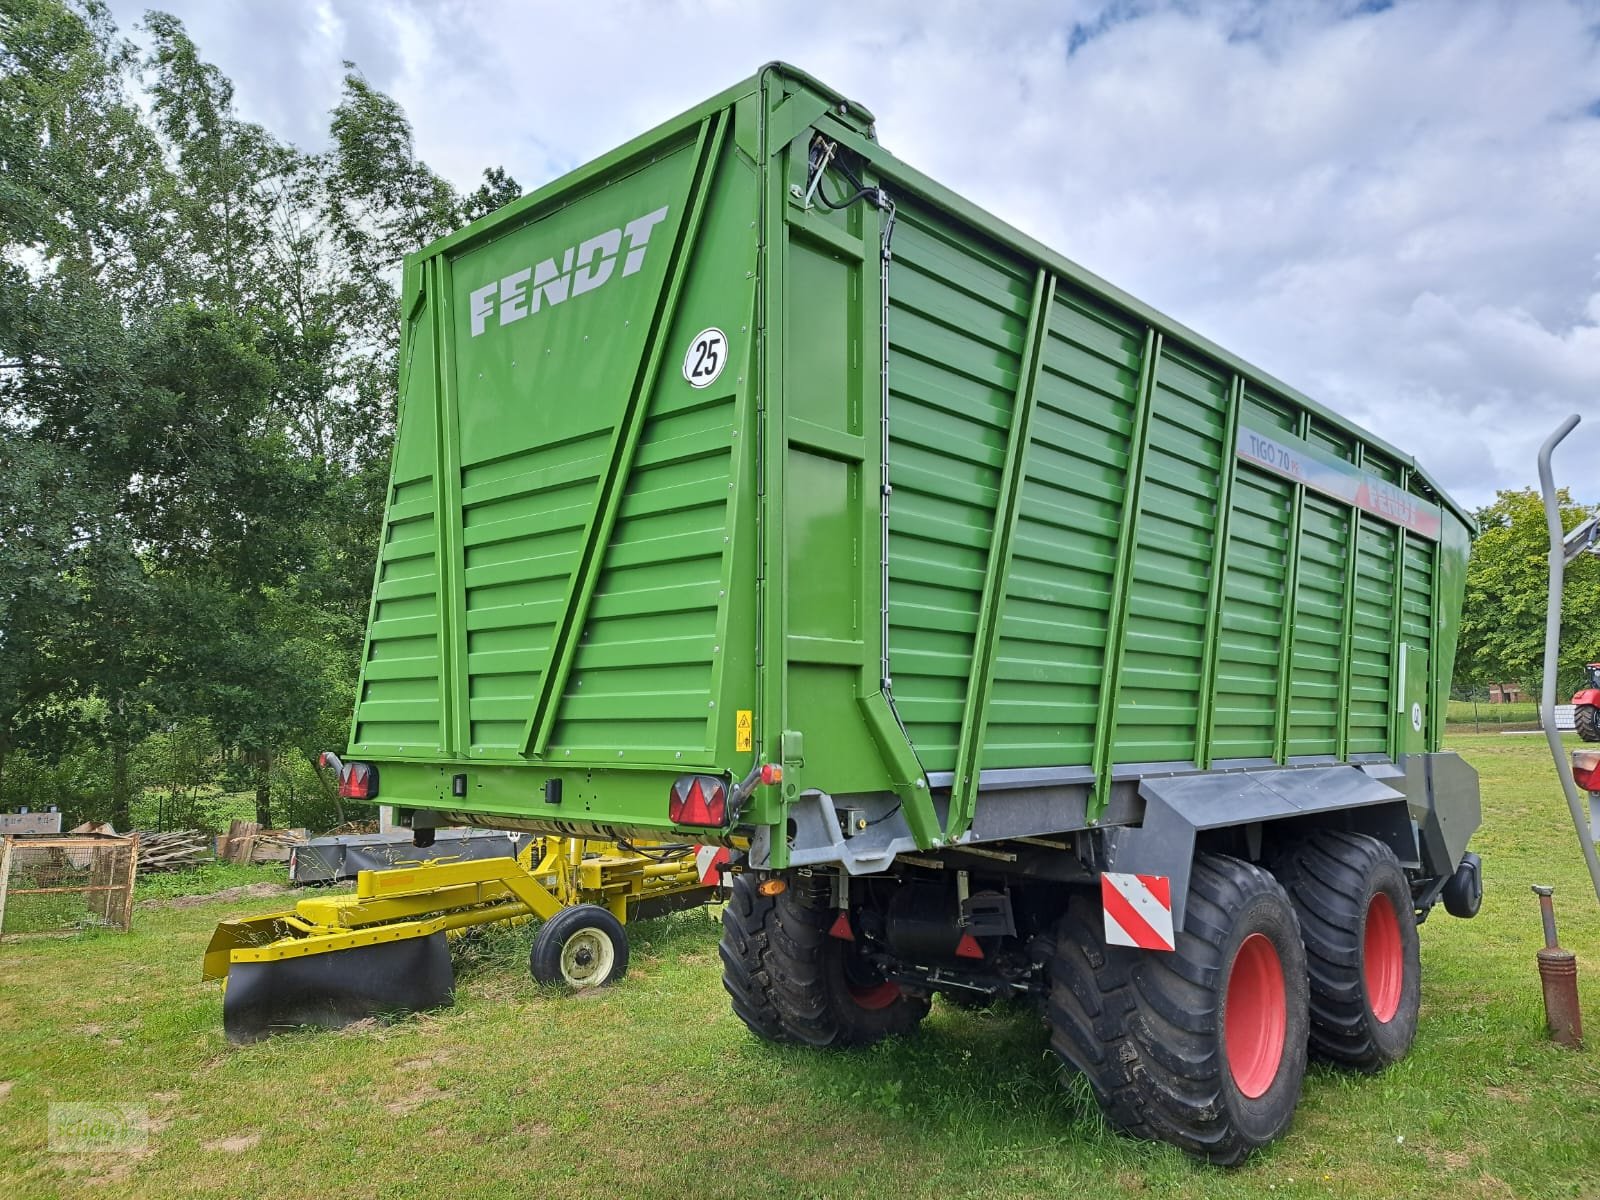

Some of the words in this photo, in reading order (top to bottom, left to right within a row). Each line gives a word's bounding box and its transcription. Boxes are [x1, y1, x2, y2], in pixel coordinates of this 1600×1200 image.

[470, 205, 669, 337] FENDT
[691, 338, 721, 378] 25
[1250, 434, 1275, 463] TIGO
[1277, 449, 1290, 470] 70
